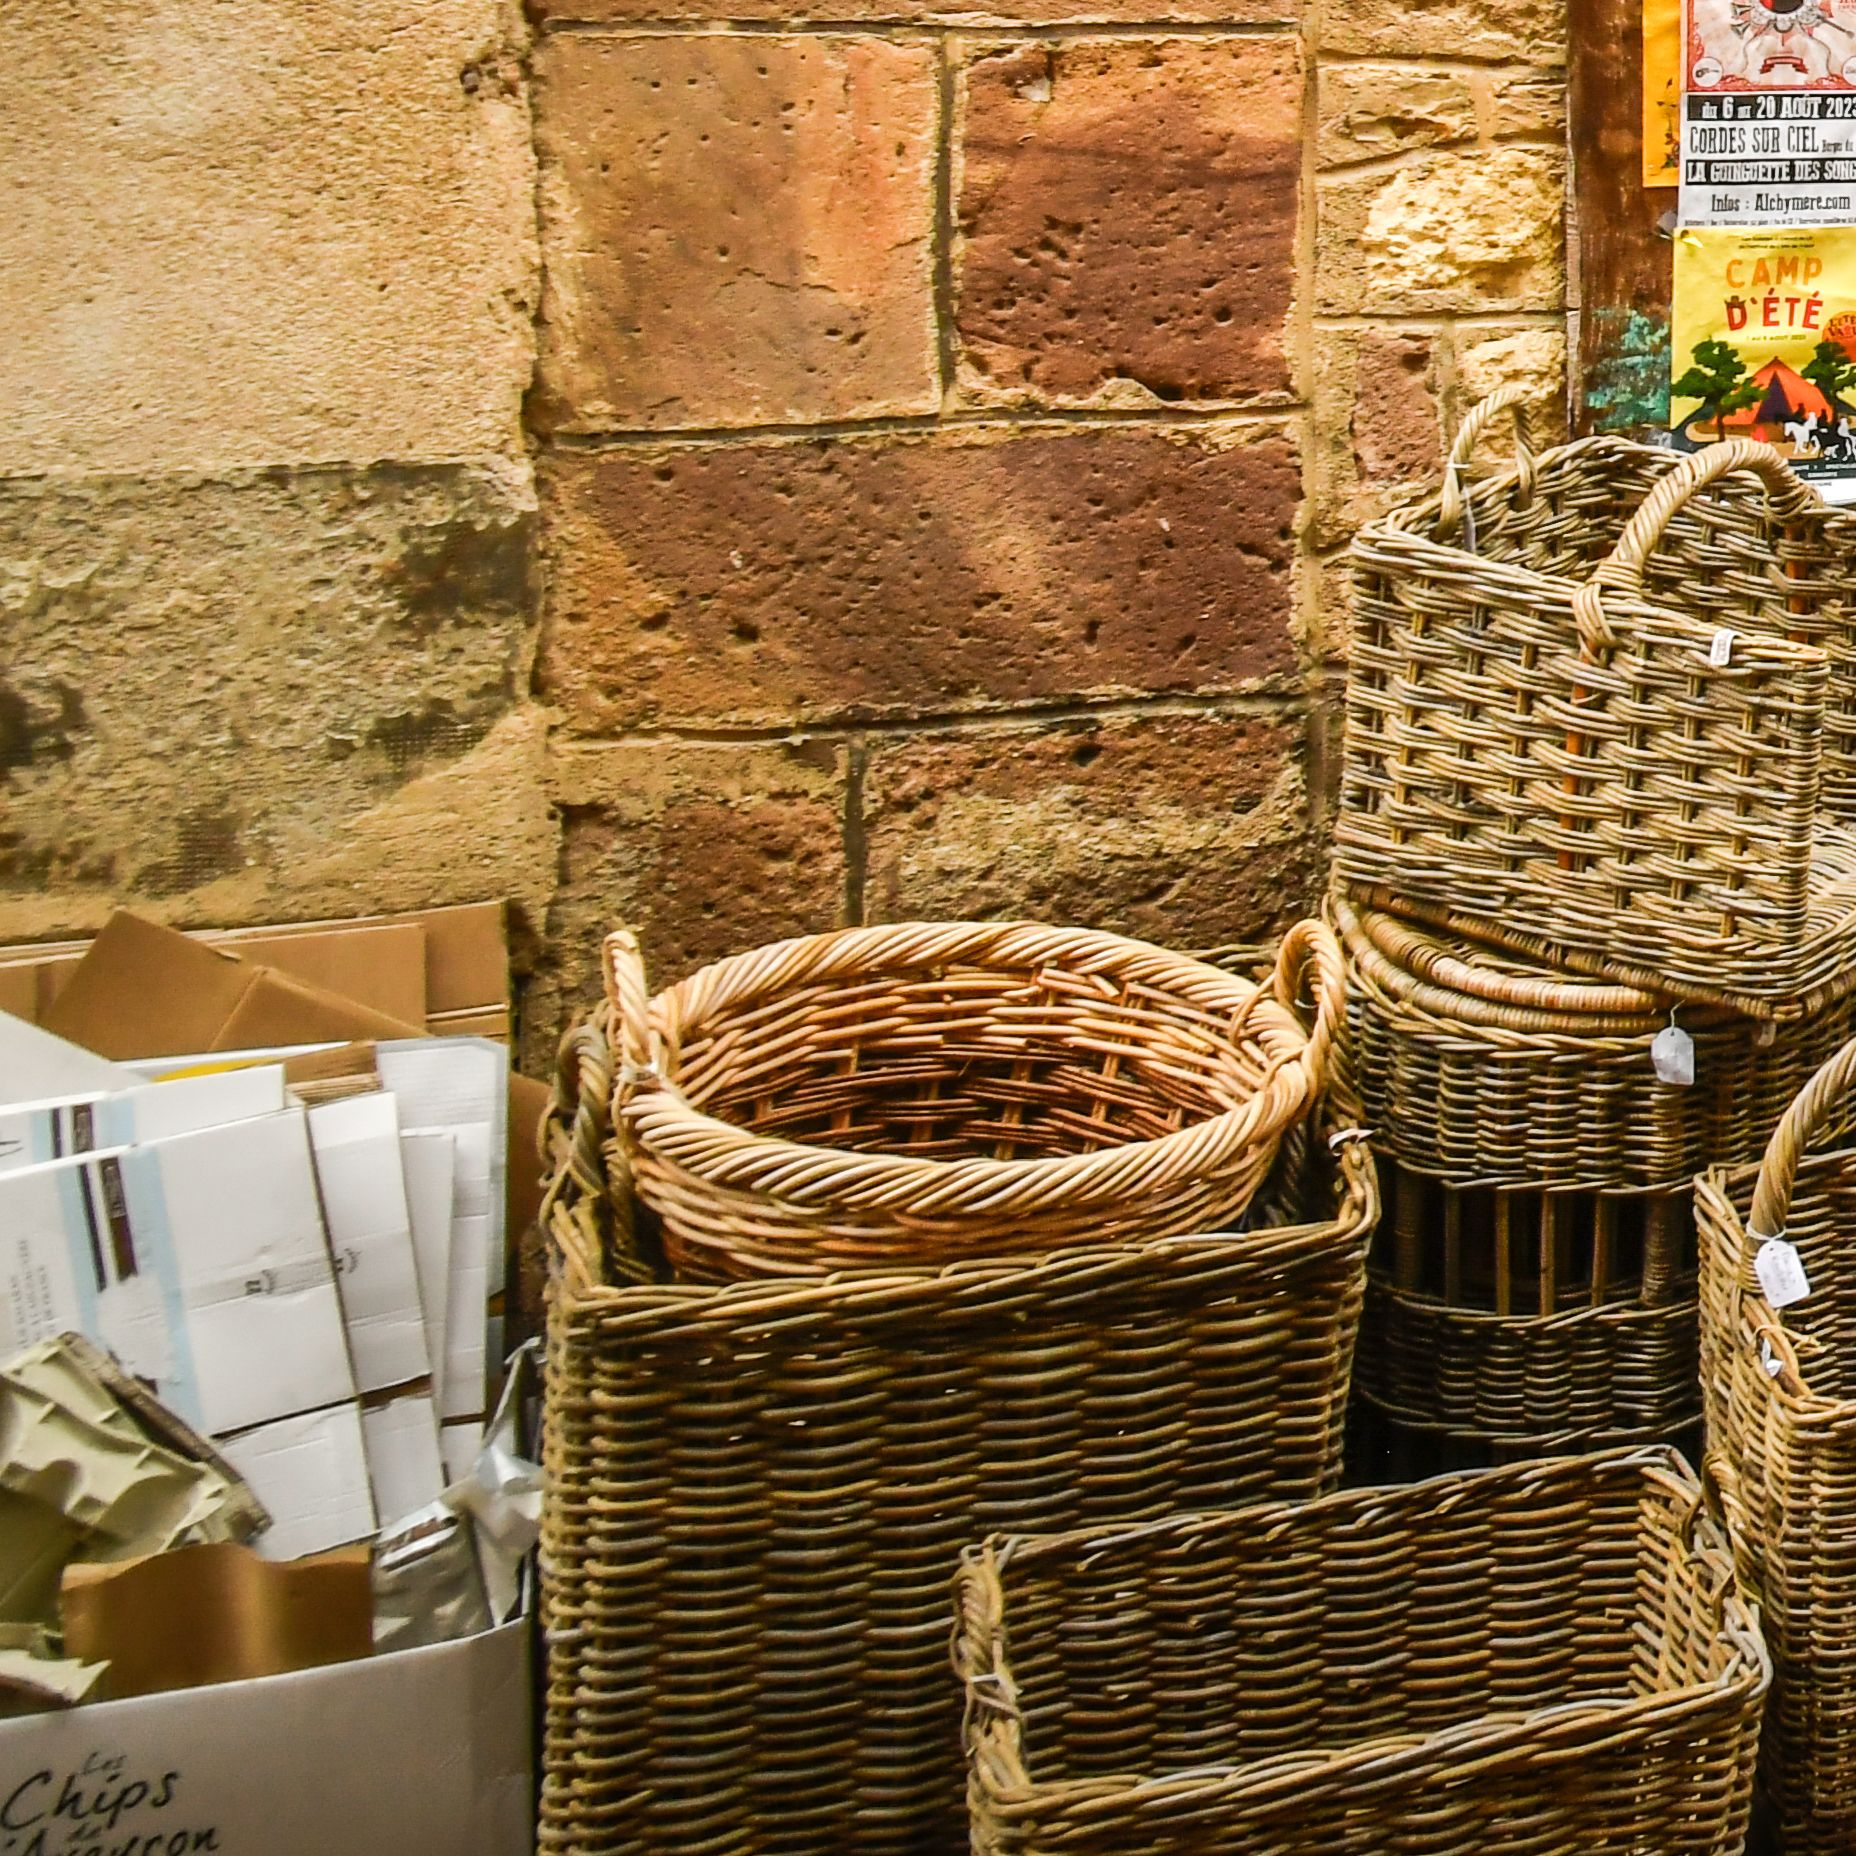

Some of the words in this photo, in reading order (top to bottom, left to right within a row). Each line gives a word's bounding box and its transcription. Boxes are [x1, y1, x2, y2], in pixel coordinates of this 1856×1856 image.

[1722, 96, 1734, 119] 6
[1756, 96, 1776, 119] 20
[1690, 126, 1746, 154] CORDES
[1752, 127, 1780, 153] SUR
[1788, 126, 1819, 153] CIEL
[1687, 162, 1707, 183] LA
[1710, 161, 1791, 182] GUINGUETTE
[1794, 161, 1821, 180] DES
[1711, 194, 1740, 212] Infos
[1726, 257, 1823, 288] CAMP
[0, 1770, 181, 1831] Chips
